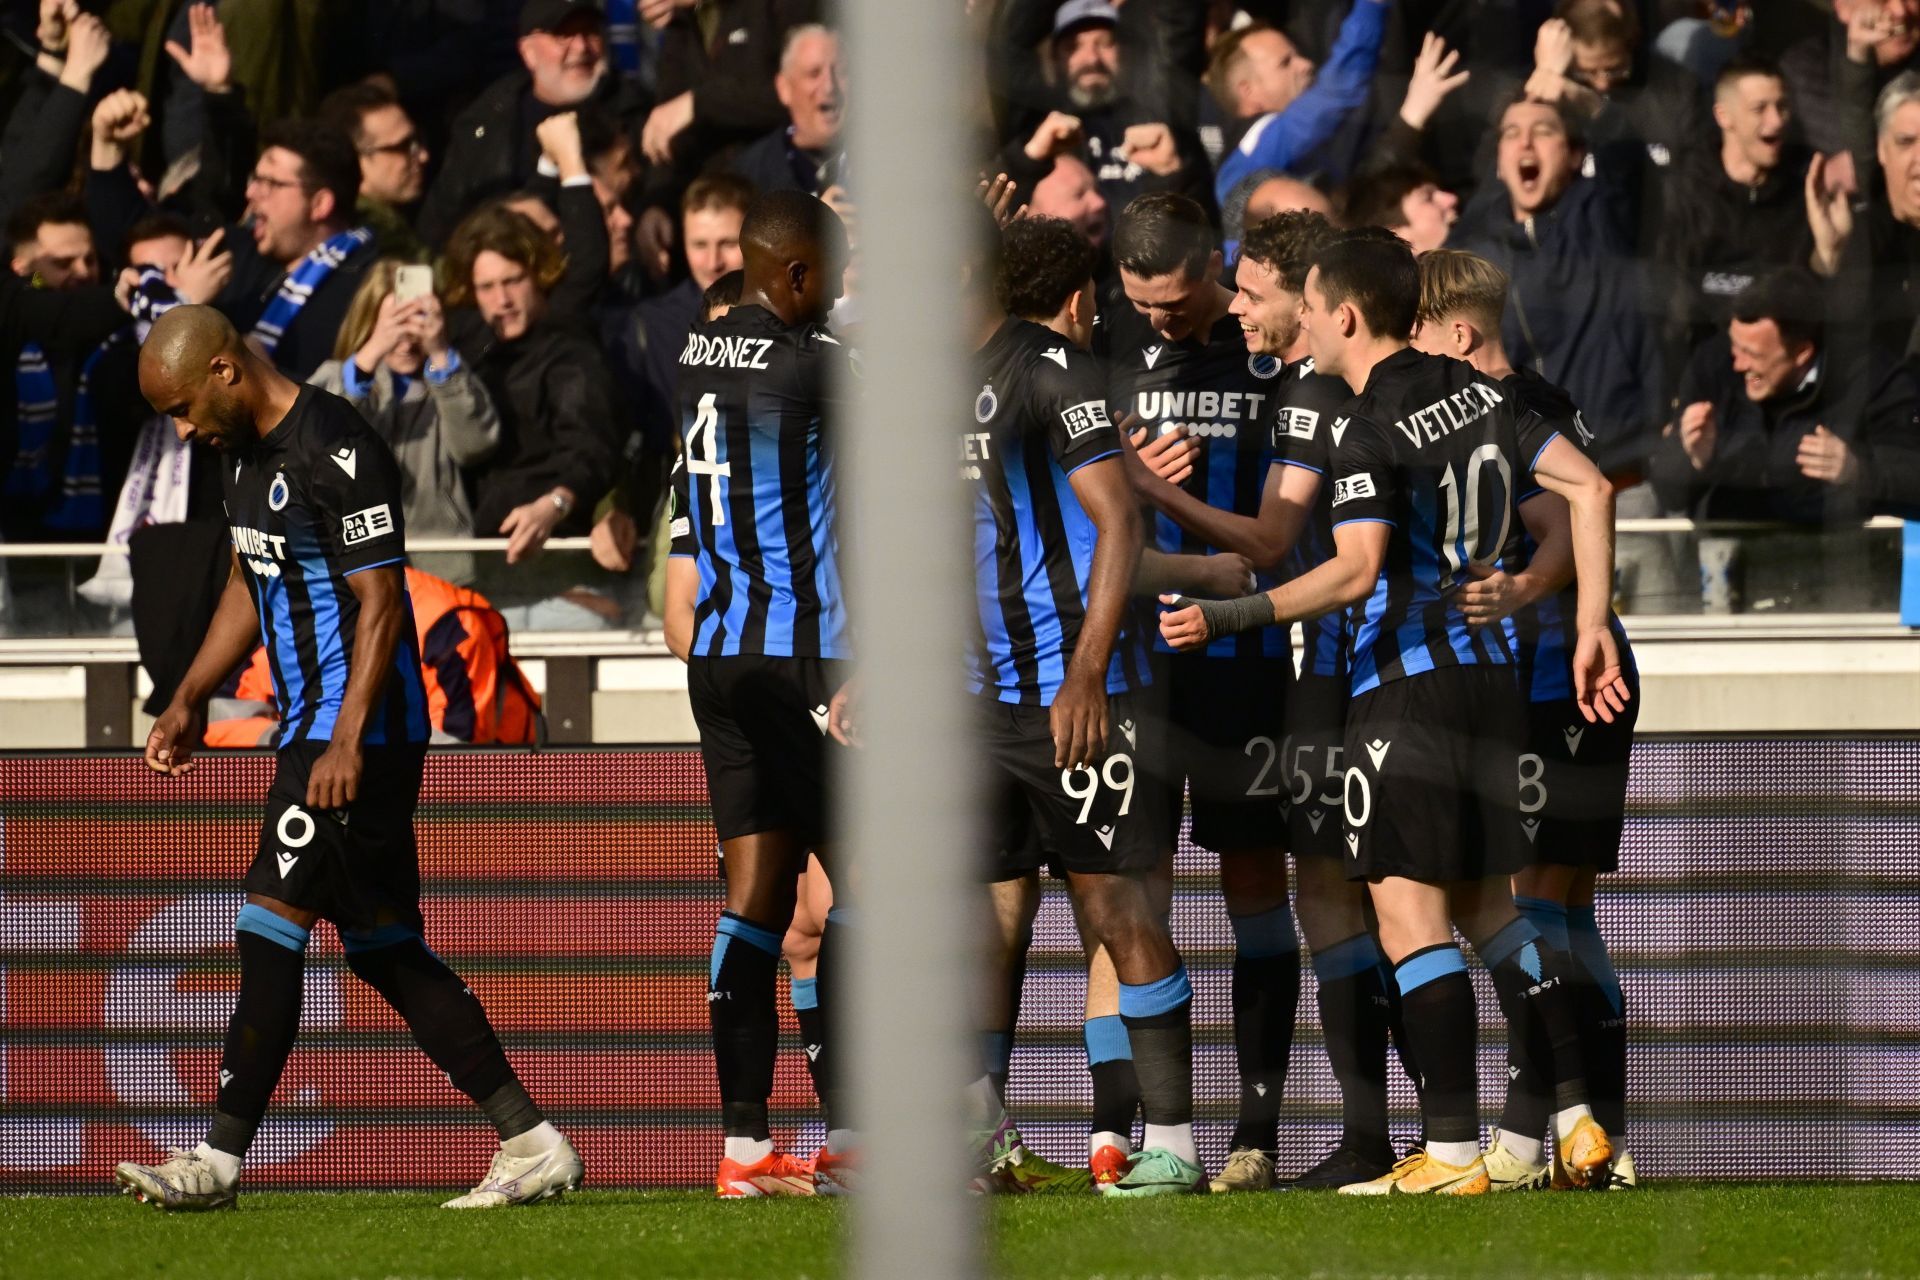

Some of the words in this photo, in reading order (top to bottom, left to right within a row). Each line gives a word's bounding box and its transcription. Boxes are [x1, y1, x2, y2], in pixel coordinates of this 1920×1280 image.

[1138, 391, 1266, 420] UNIBET
[686, 393, 731, 526] 4
[960, 432, 991, 461] ET
[1438, 443, 1512, 590] 10
[1061, 753, 1135, 825] 99
[277, 804, 315, 848] 6
